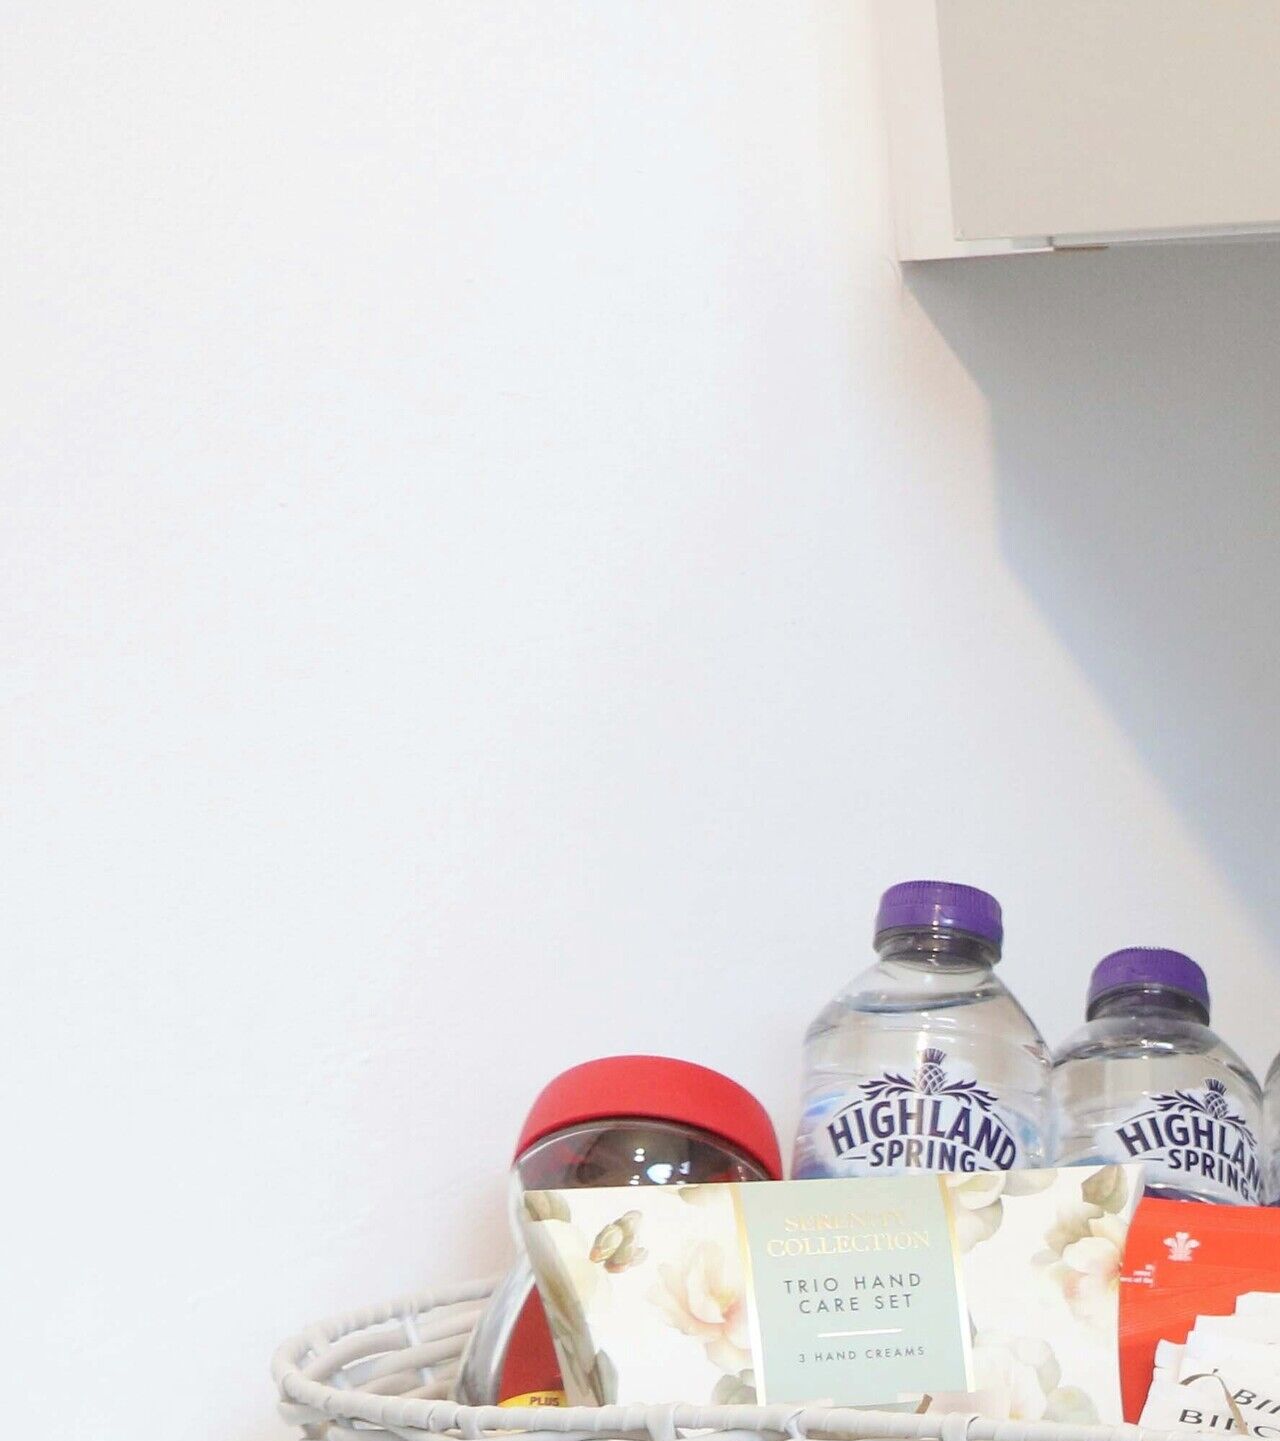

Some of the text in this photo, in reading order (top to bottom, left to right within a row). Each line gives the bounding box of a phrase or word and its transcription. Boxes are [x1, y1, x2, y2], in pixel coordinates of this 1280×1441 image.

[826, 1098, 1017, 1171] HIGHLAND
[870, 1139, 976, 1173] SPRING
[1168, 1149, 1249, 1200] SPRING
[784, 1208, 906, 1233] SERENITY
[766, 1231, 931, 1258] COLLECTION
[783, 1273, 922, 1295] TRIO HAND
[799, 1294, 913, 1314] CARE SET
[799, 1346, 926, 1363] 3 HAND CREAMS
[529, 1396, 560, 1407] PLUS
